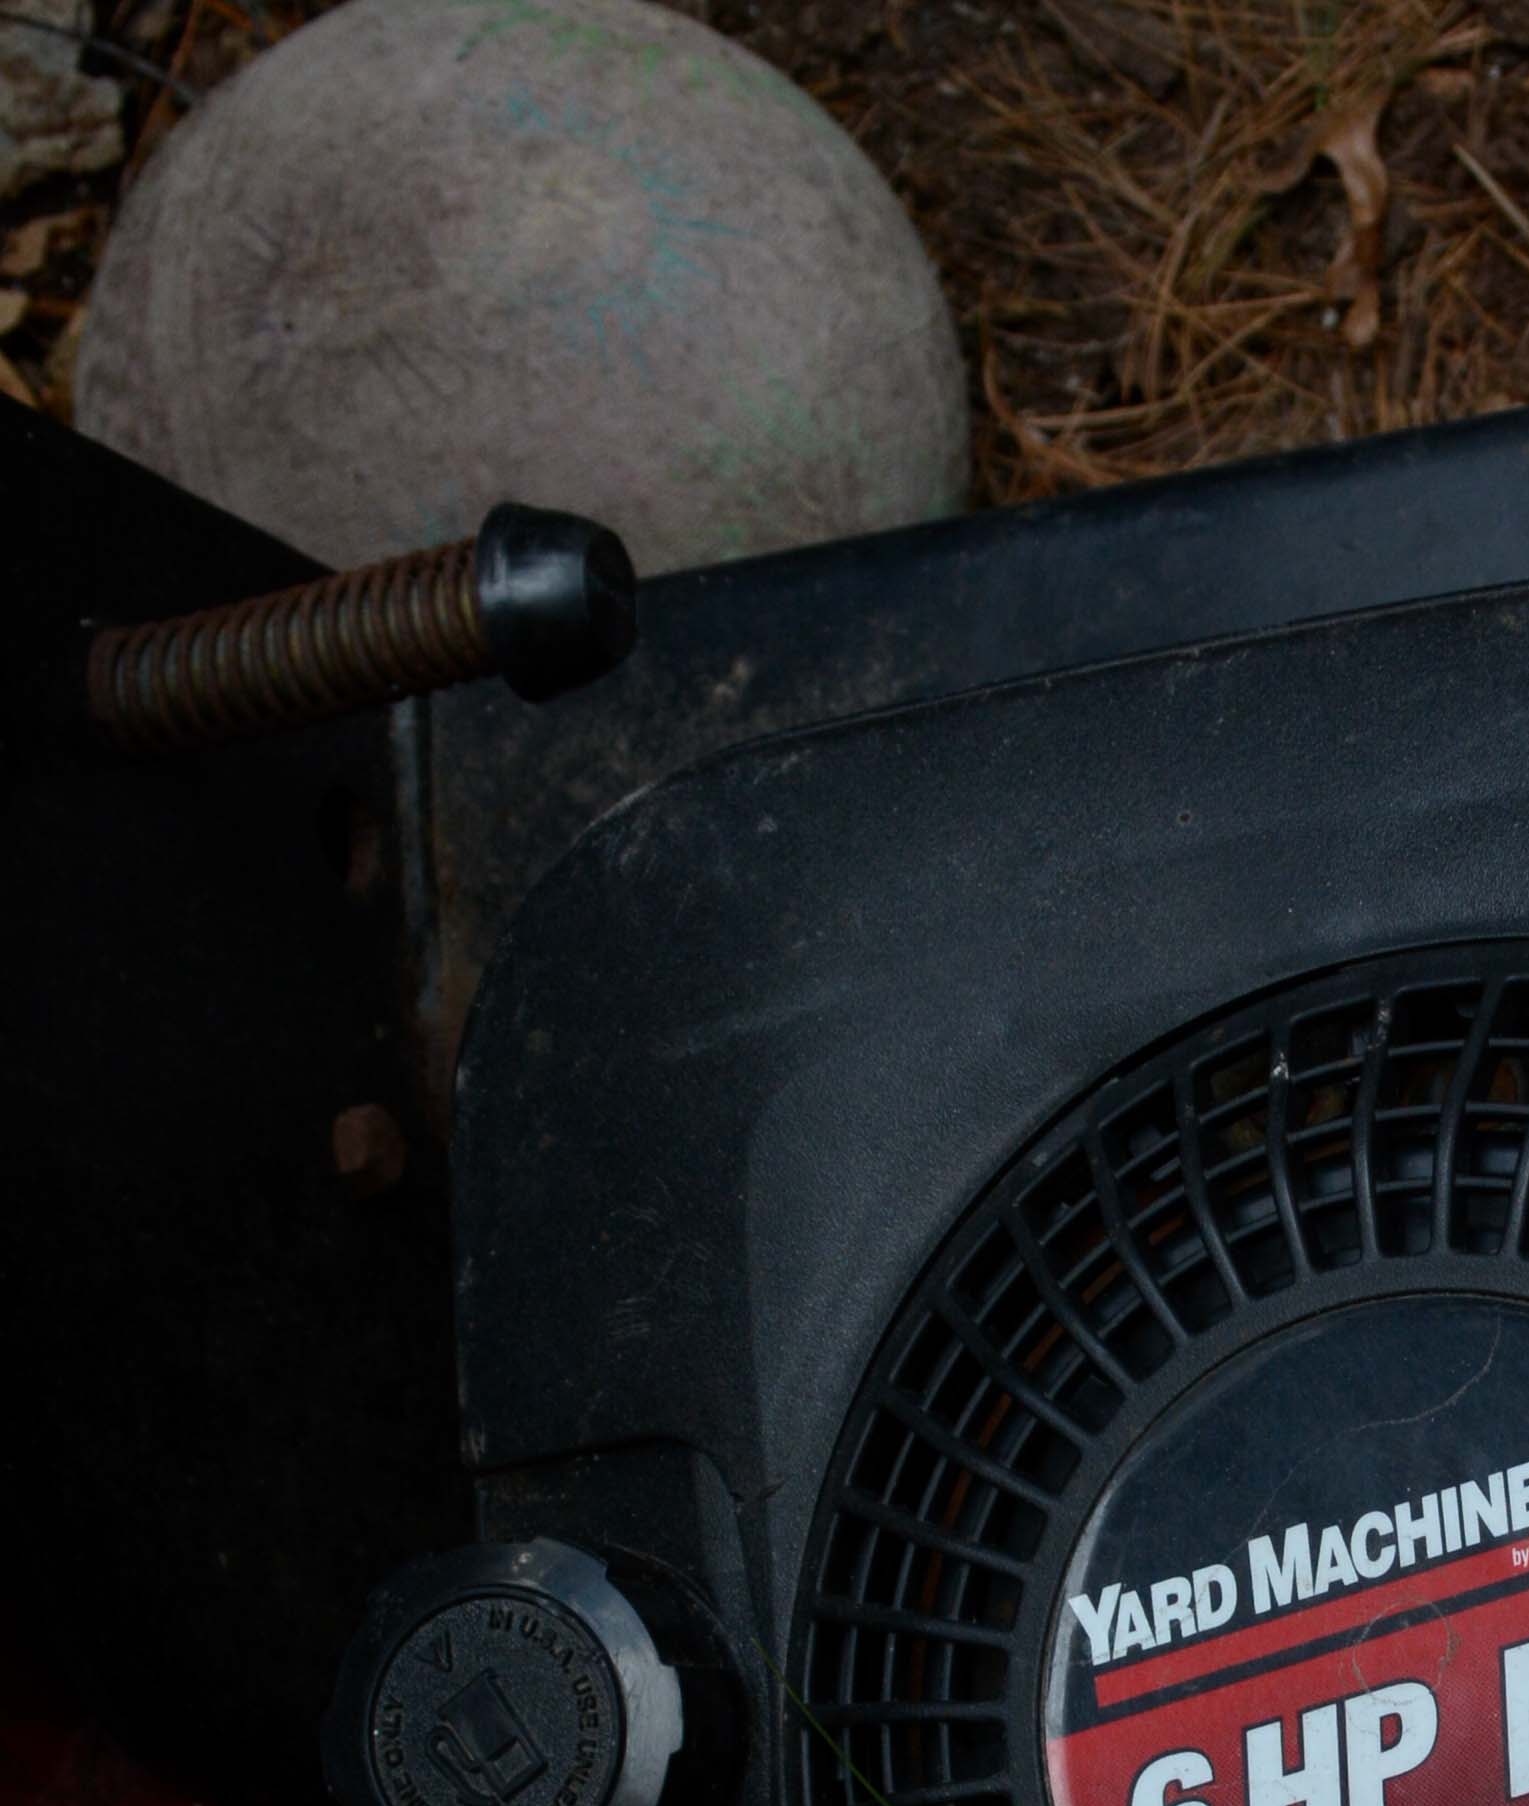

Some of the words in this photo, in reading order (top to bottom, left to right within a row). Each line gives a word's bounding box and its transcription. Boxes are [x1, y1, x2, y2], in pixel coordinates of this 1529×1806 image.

[1511, 1546, 1529, 1569] by
[1068, 1563, 1238, 1668] YARD
[380, 1694, 406, 1769] ONLY
[572, 1675, 601, 1733] USE
